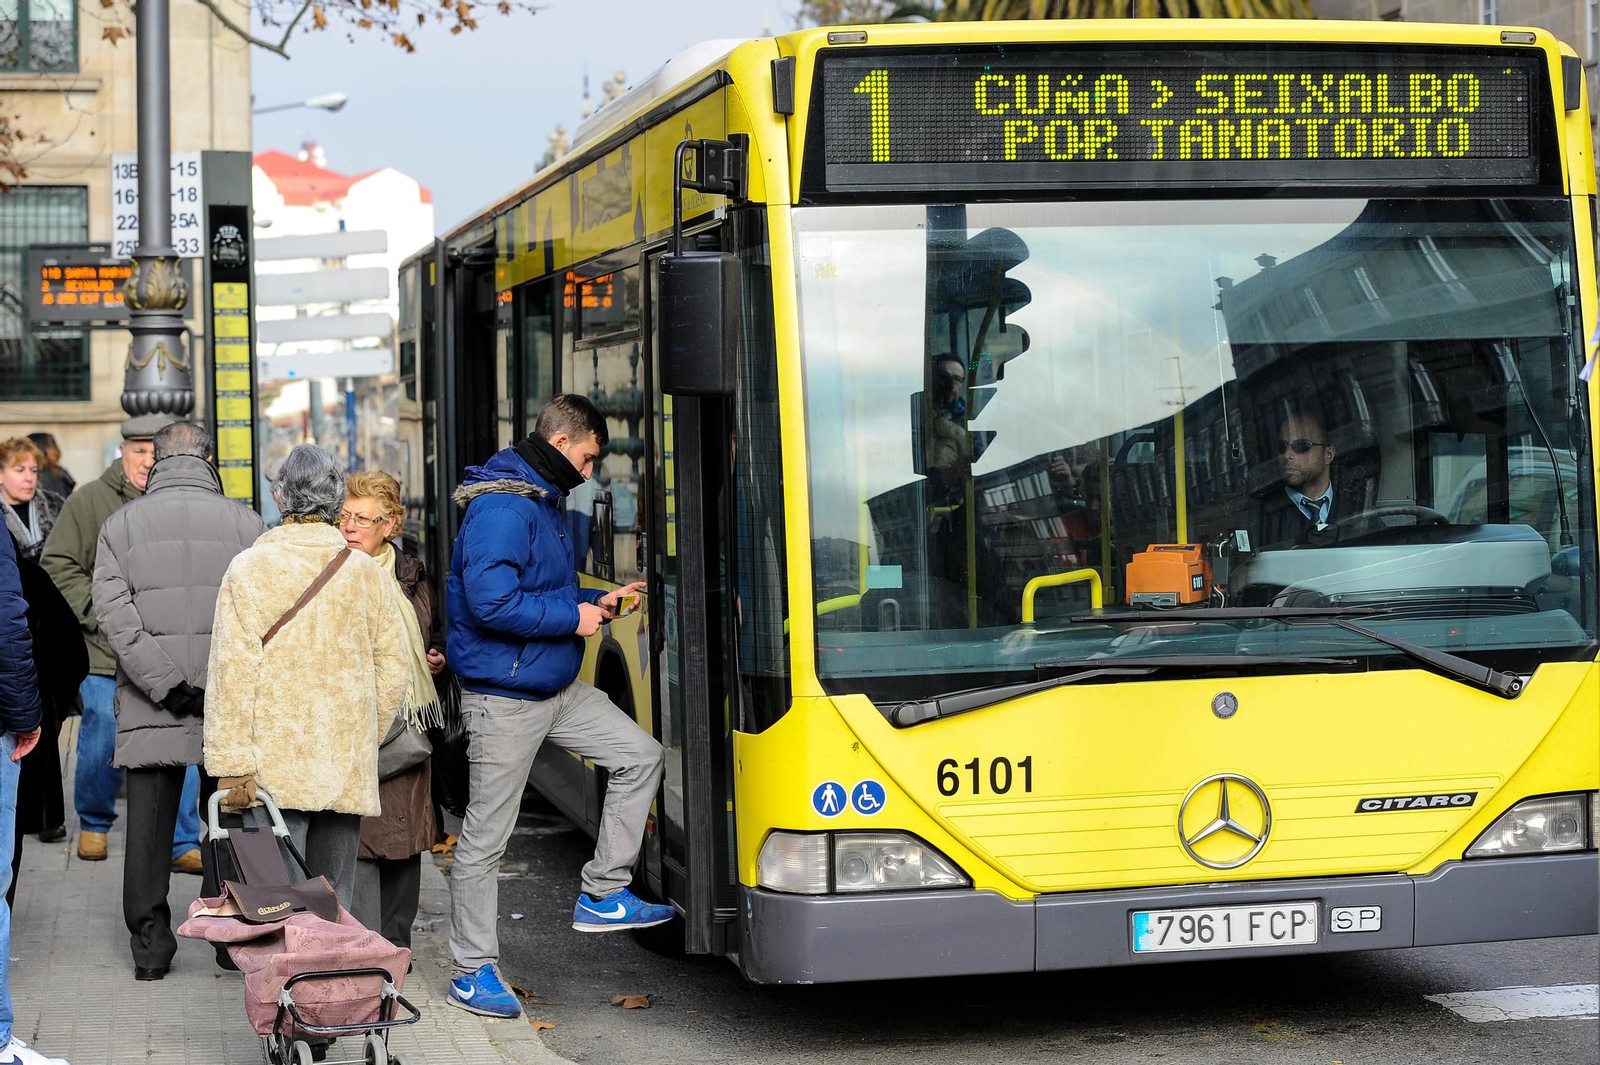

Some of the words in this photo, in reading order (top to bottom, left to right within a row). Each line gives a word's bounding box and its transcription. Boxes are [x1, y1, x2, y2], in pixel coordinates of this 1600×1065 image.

[1195, 73, 1480, 114] SEIXALBO
[854, 69, 890, 162] 1
[1004, 119, 1118, 160] POR
[1140, 118, 1470, 160] TANATORIO
[937, 755, 1032, 796] 6101
[1361, 794, 1472, 811] CITARO
[1157, 912, 1232, 946] 7961
[1249, 909, 1307, 942] FCP
